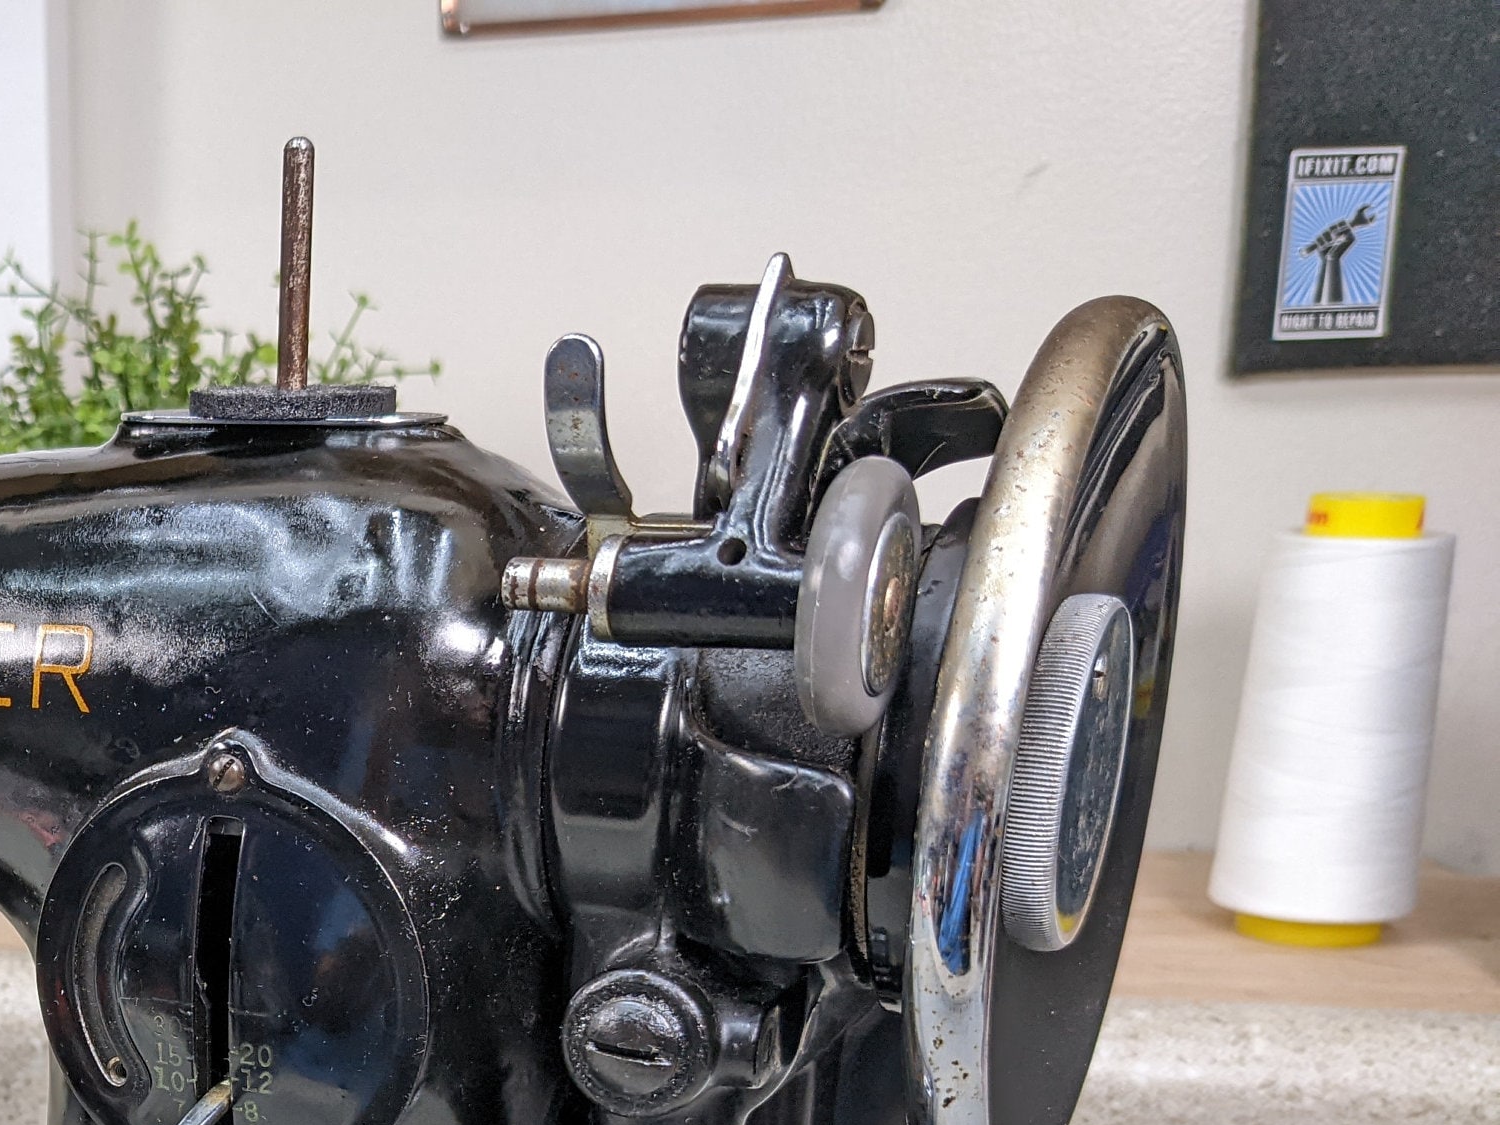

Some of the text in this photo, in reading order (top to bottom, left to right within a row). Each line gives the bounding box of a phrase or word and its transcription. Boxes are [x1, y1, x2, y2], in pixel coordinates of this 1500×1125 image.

[1297, 155, 1395, 177] IFIXIT.COM
[1319, 312, 1333, 330] TO
[1336, 311, 1376, 330] REPAIR
[155, 1042, 182, 1067] 15
[239, 1042, 273, 1068] 20
[153, 1065, 185, 1092] 10
[240, 1067, 274, 1095] 12
[244, 1101, 259, 1122] 8
